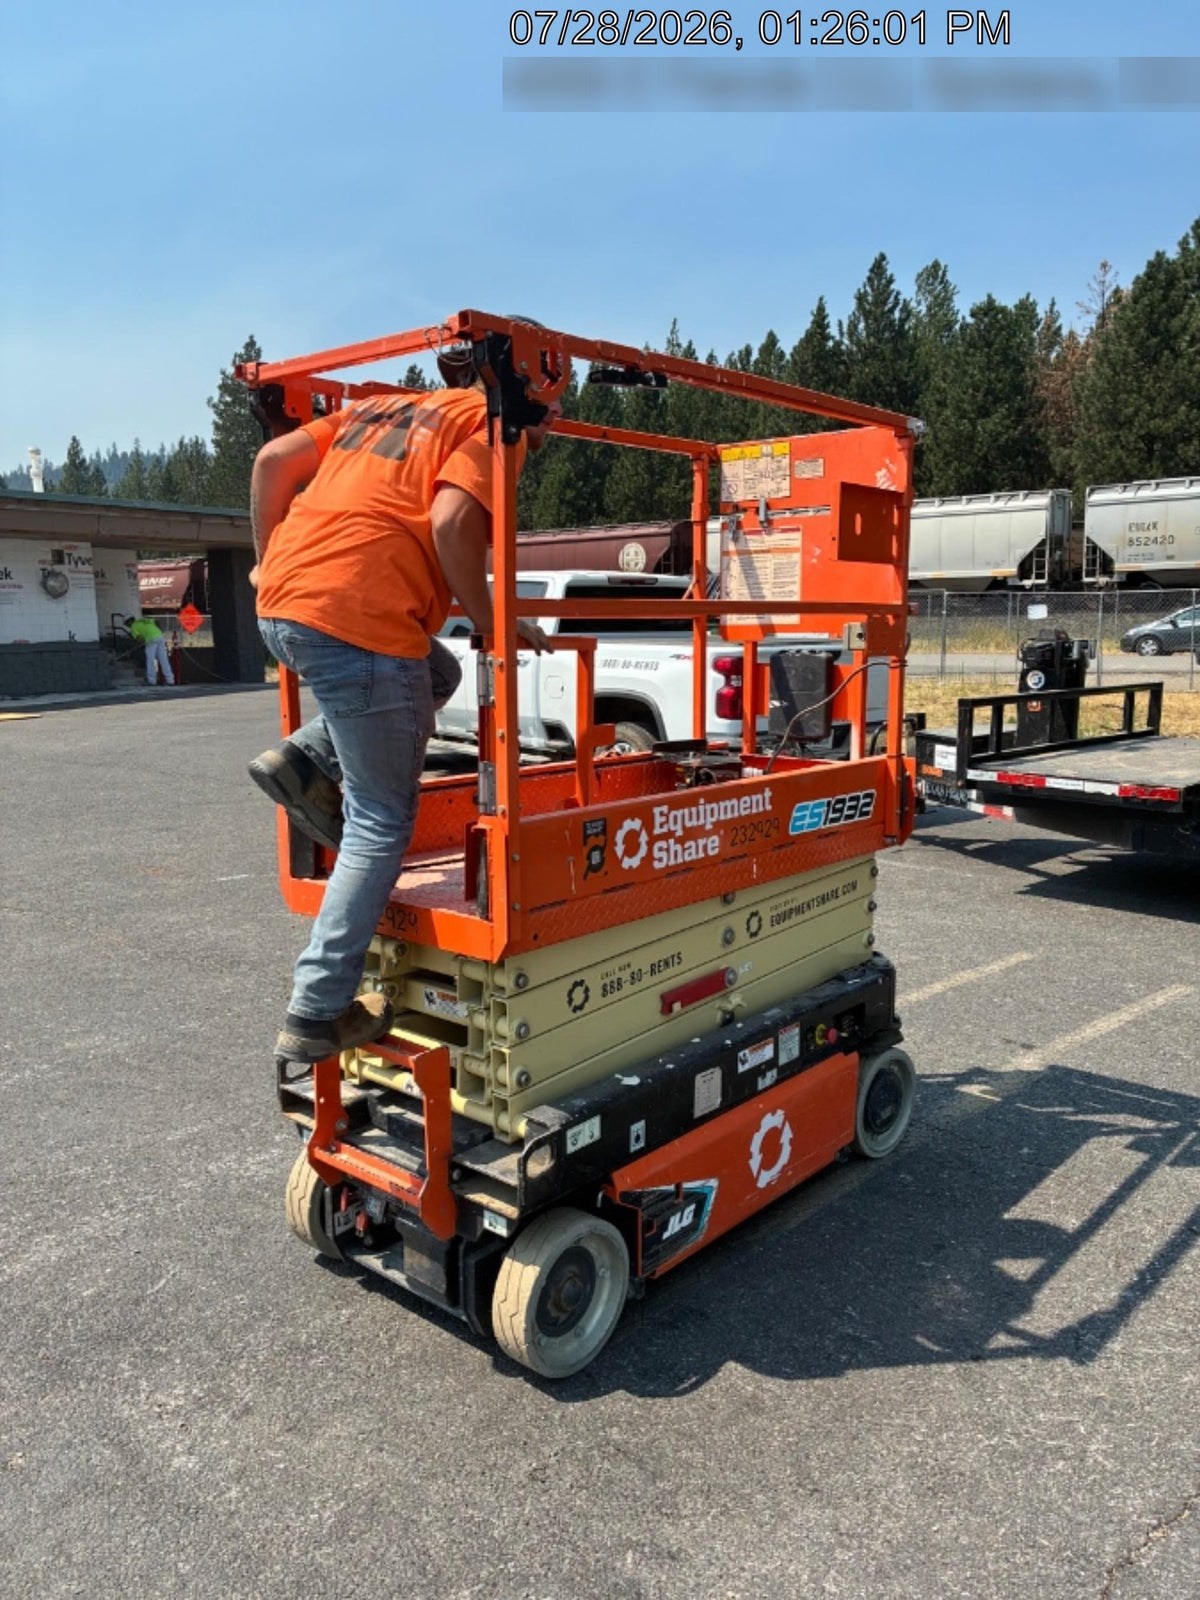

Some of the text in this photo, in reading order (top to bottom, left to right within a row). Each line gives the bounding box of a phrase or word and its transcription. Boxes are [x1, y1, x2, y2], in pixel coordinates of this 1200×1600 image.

[1128, 534, 1175, 547] 852420
[652, 786, 772, 837] Equipment
[788, 789, 876, 836] ES1932
[652, 833, 720, 870] Share
[769, 880, 859, 927] EQUIPMENTSHARE.COM
[600, 951, 684, 999] 888-80-RENTS
[661, 1203, 696, 1241] JLG
